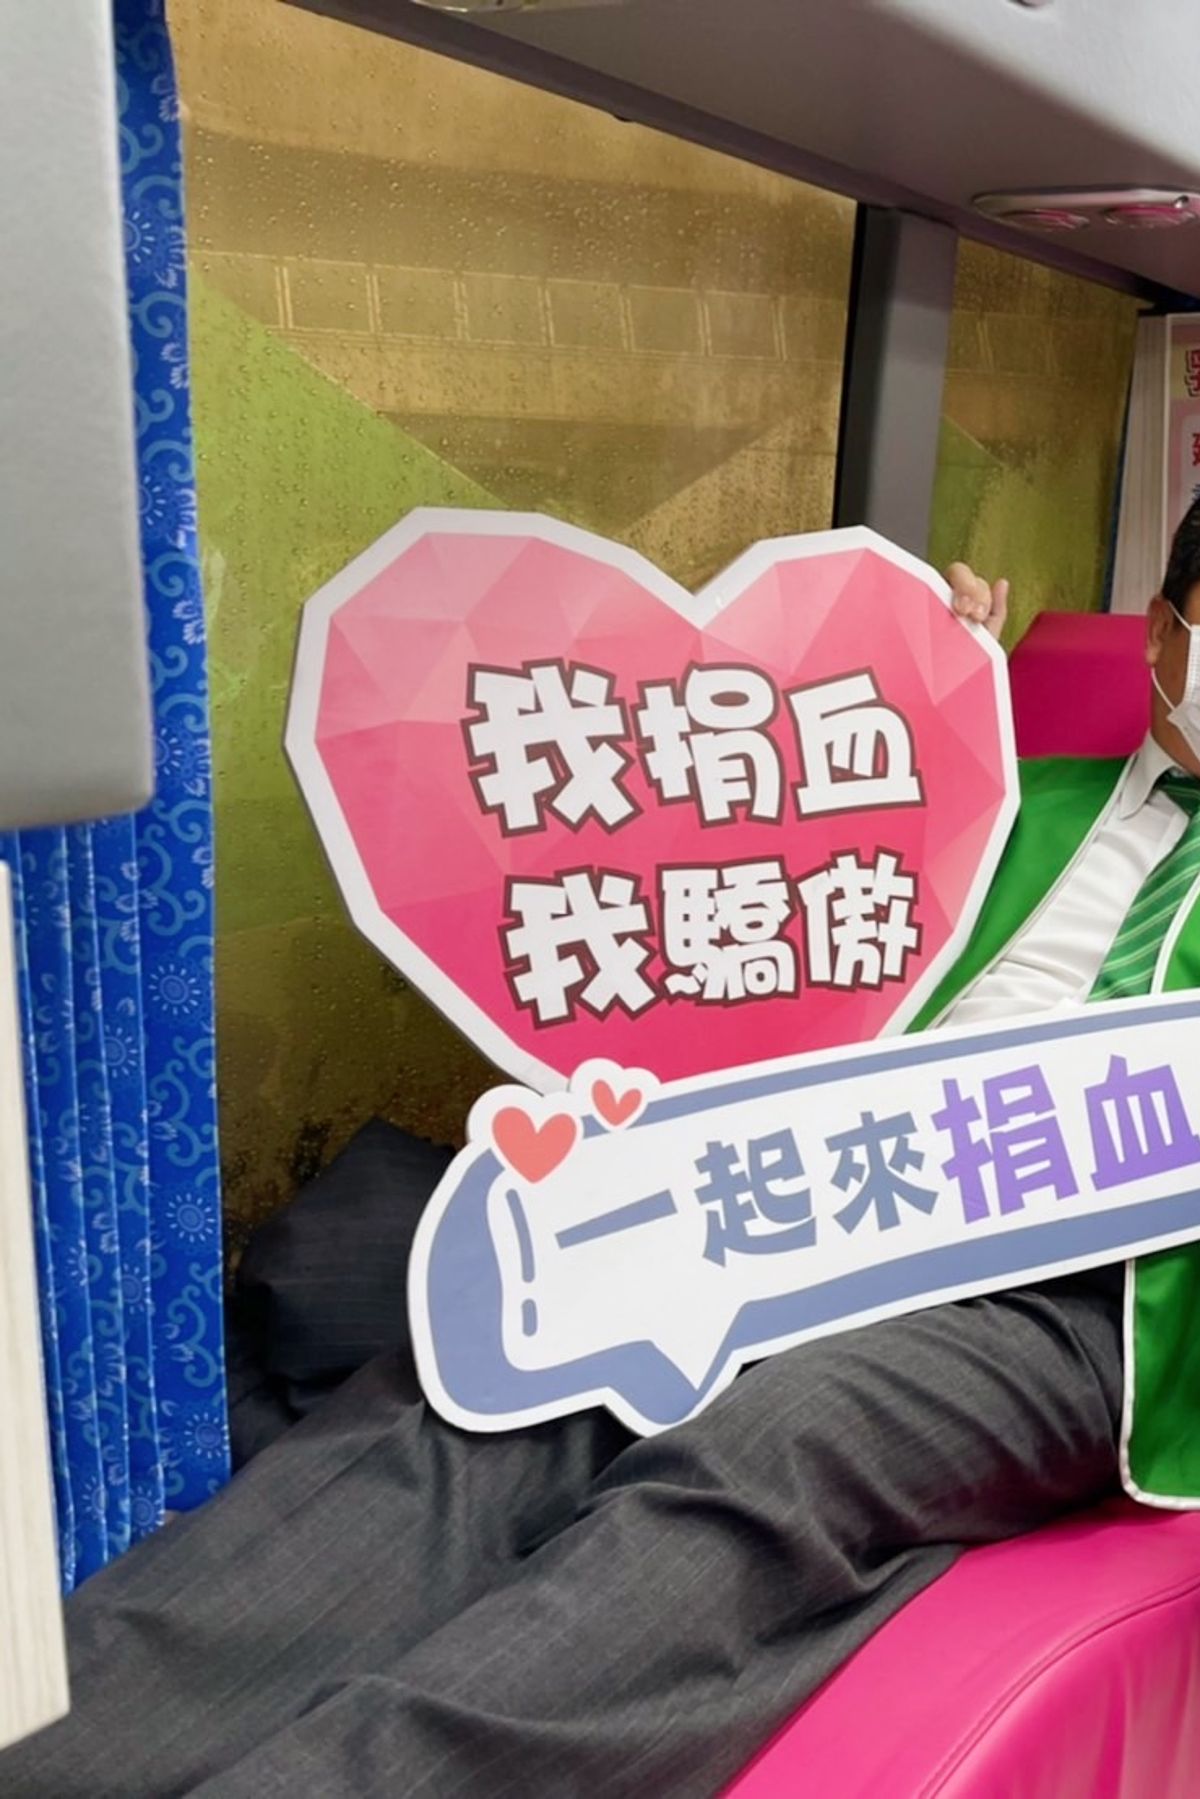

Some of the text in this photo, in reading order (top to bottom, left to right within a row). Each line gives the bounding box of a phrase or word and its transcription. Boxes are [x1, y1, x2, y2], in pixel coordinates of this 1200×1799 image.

[461, 657, 926, 838] 我捐血
[498, 846, 922, 1030] 我驕傲
